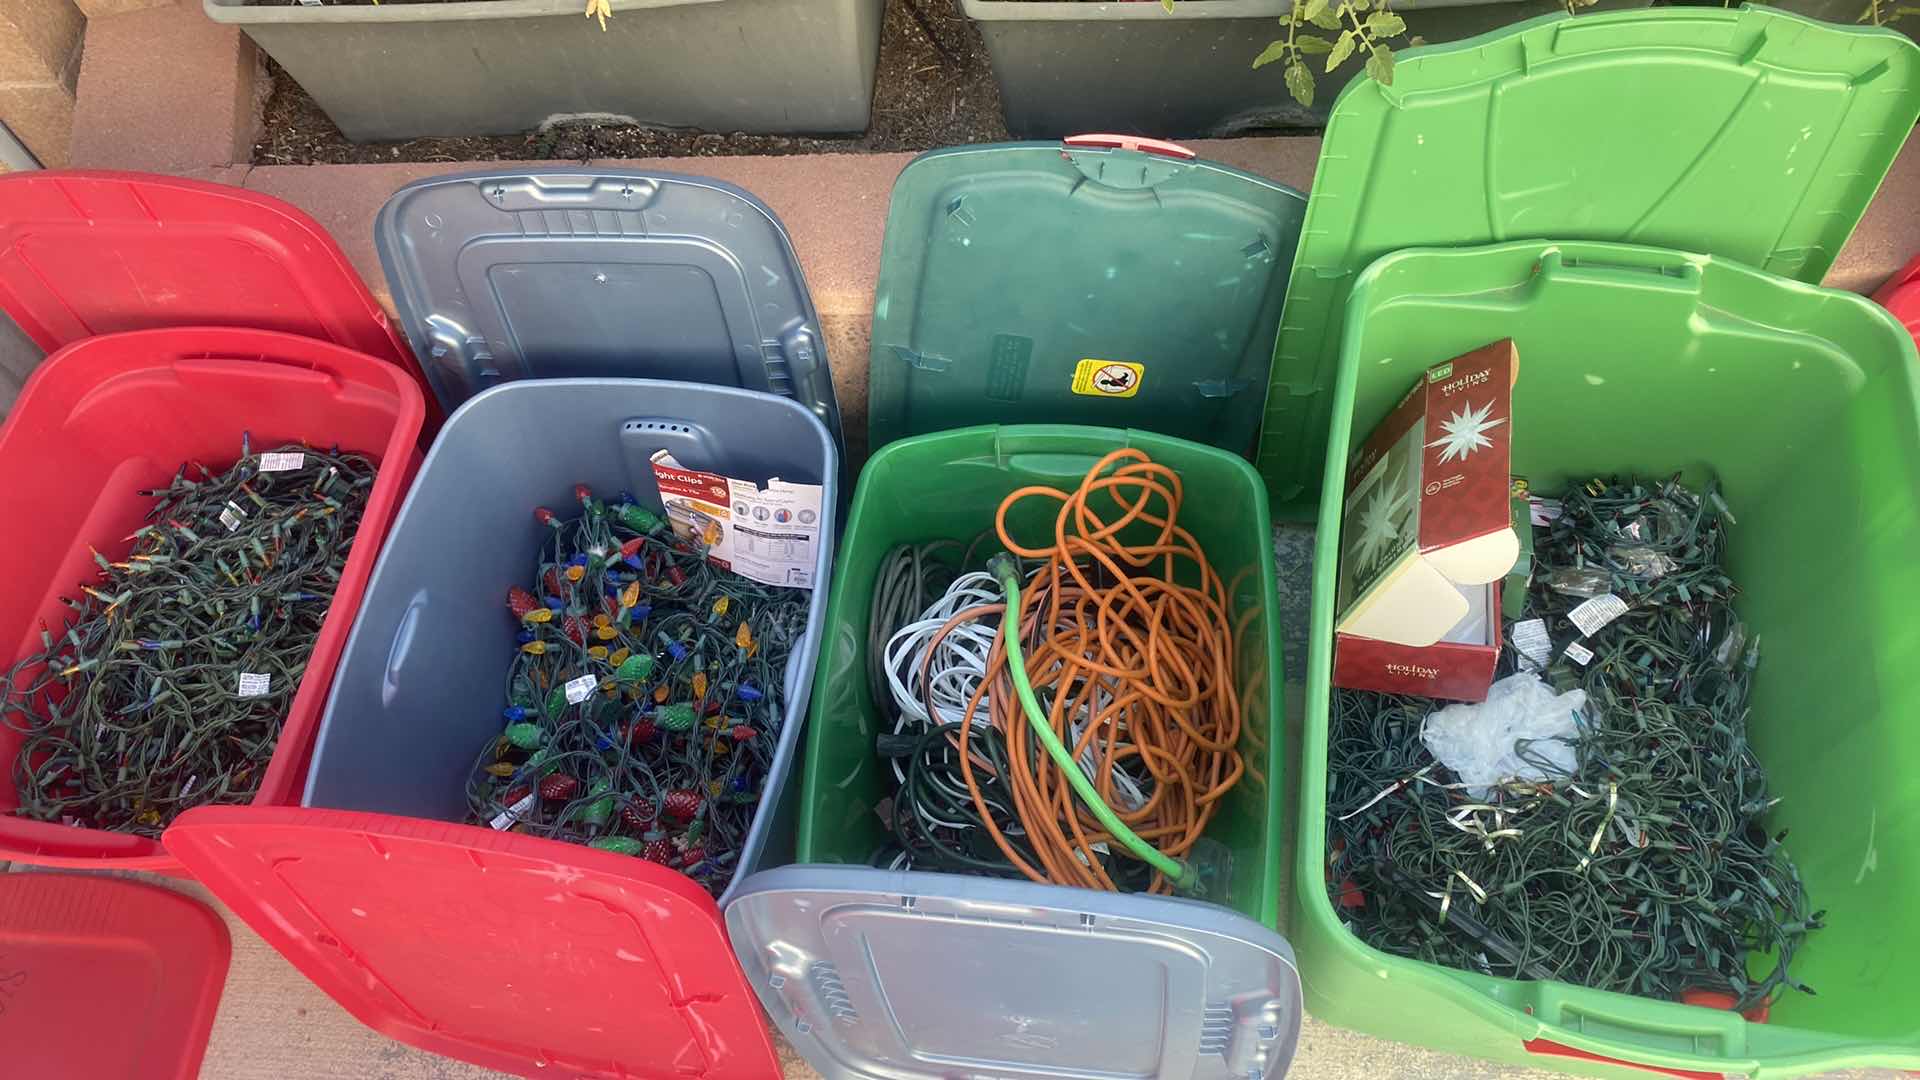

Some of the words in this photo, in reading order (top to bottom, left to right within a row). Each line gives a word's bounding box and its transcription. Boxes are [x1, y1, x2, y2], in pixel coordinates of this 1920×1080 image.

[1431, 367, 1451, 380] LED
[1441, 367, 1492, 393] HOLIDAY
[677, 474, 704, 485] Clips
[1384, 663, 1440, 675] HOLIDAY
